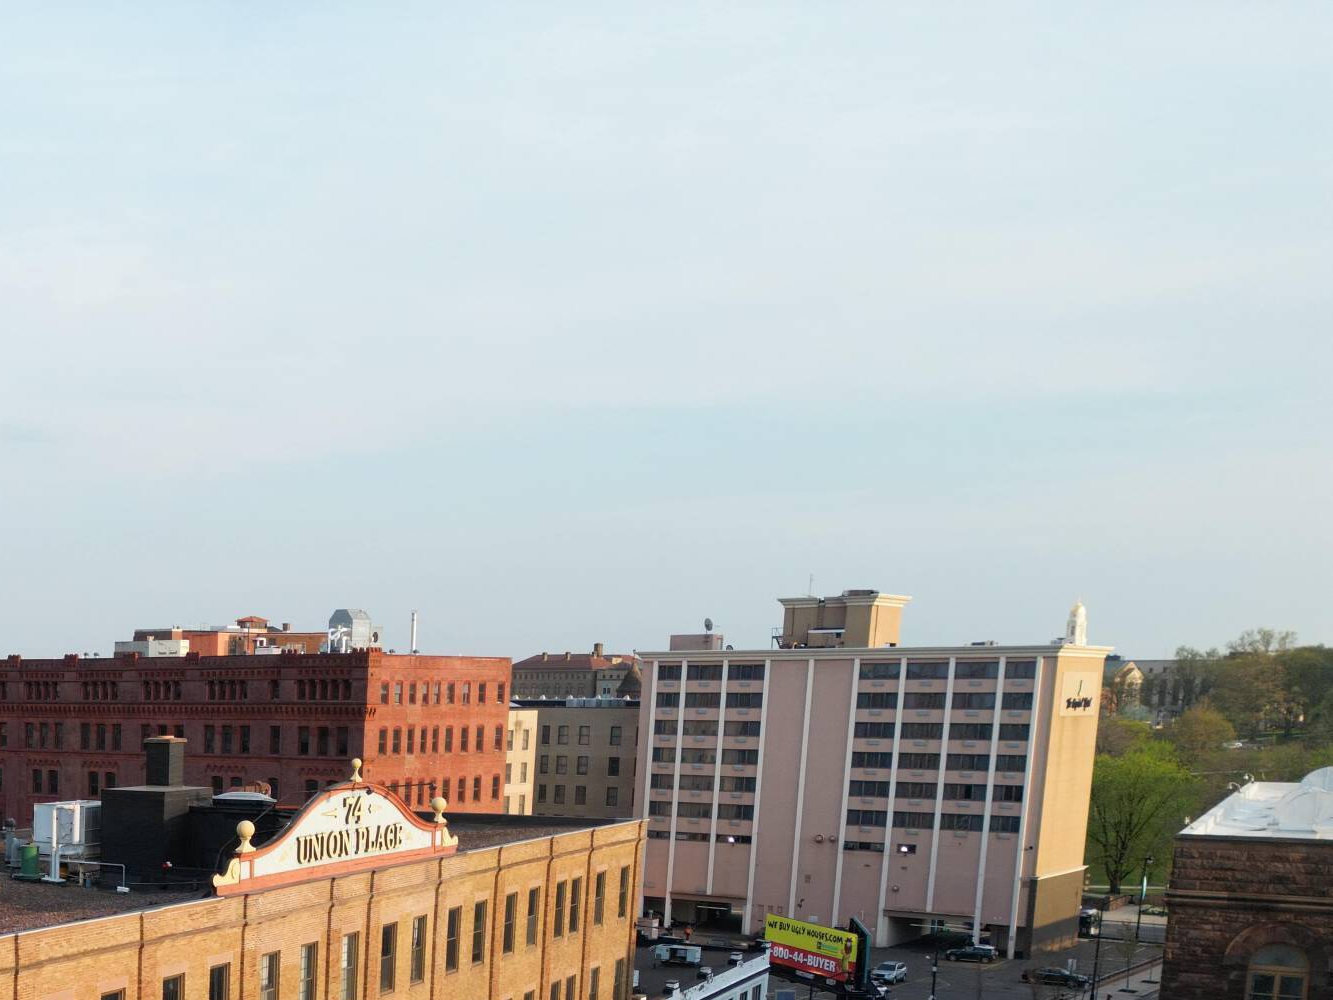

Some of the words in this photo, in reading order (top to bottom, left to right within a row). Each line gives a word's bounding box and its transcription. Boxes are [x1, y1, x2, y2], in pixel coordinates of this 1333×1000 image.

[342, 795, 364, 825] 74
[296, 831, 353, 864] UNION
[355, 823, 404, 854] PLACE
[779, 921, 790, 931] BUY
[791, 924, 805, 934] UGLY
[769, 945, 836, 972] -800-44-BUYER
